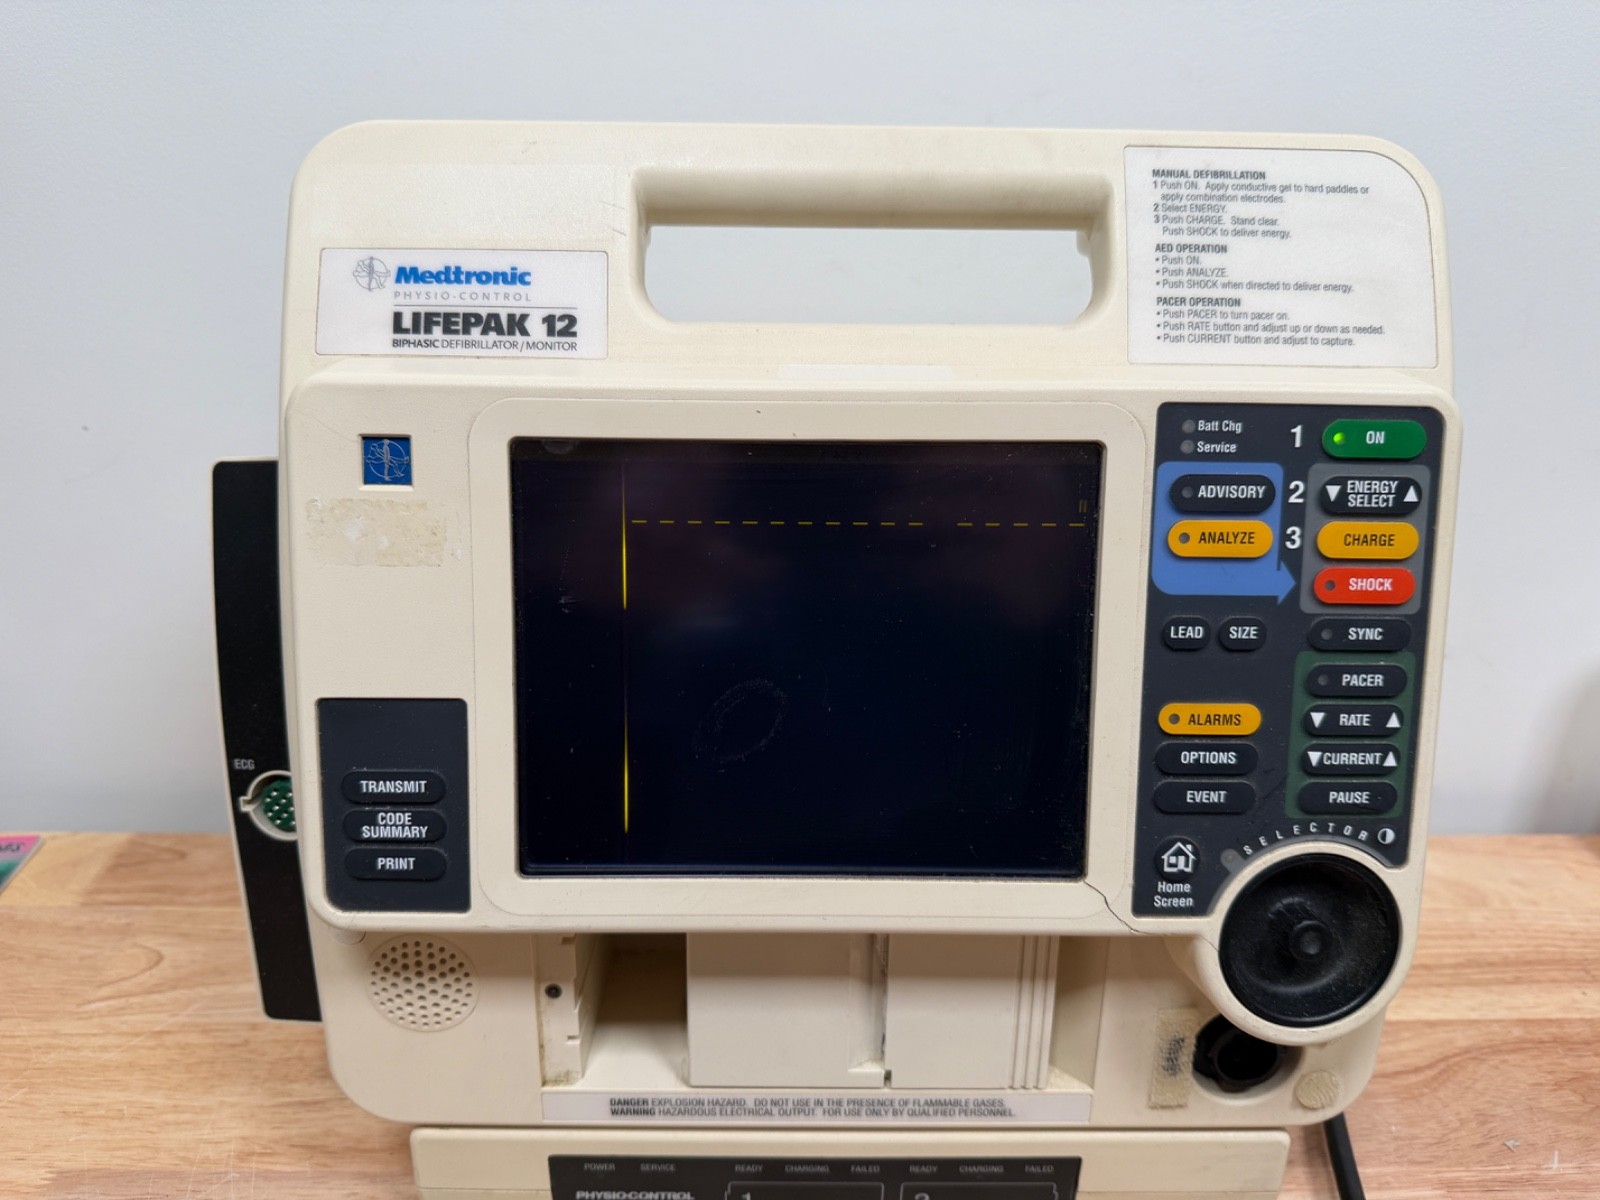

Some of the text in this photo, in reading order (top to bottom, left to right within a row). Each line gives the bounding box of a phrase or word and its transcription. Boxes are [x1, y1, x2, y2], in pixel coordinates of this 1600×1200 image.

[1152, 169, 1266, 180] MANUAL DEFIBRILLATION
[1152, 181, 1369, 195] 1 Push ON. Apply conductive gel to hard paddles or
[1160, 192, 1286, 203] apply combination electrodes.
[1153, 203, 1227, 214] 2 Select ENERGY.
[1153, 215, 1280, 226] 3 Push CHARGE. Stand clear.
[1162, 226, 1292, 240] Push SHOCK to deliver energy.
[1155, 243, 1228, 254] AED OPERATION
[1161, 255, 1202, 265] Push ON.
[394, 265, 532, 286] Medtronic
[1162, 267, 1229, 278] Push ANALYZE.
[1162, 279, 1354, 294] Push SHOCK when directed to deliver energy.
[394, 290, 532, 302] PHYSIO-CONTROL
[1156, 296, 1241, 307] PACER OPERATION
[1162, 309, 1290, 321] Push PACER to turn pacer on.
[392, 310, 578, 338] LIFEPAK 12
[1163, 321, 1385, 335] Push RATE button and adjust up or down as needed.
[392, 338, 578, 352] BIPHASIC DEFIBRILLATOR/MONITOR
[1163, 333, 1355, 347] Push CURRENT button and adjust to capture.
[1197, 420, 1243, 435] Batt Chg
[1290, 424, 1304, 448] 1
[1365, 430, 1385, 445] ON
[1197, 440, 1237, 453] Service
[1198, 485, 1266, 499] ADVISORY
[1288, 480, 1305, 503] 2
[1347, 480, 1399, 494] ENERGY
[1347, 494, 1396, 508] SELECT
[1198, 531, 1255, 545] ANALYZE
[1285, 526, 1302, 549] 3
[1343, 533, 1395, 547] CHARGE
[1348, 577, 1393, 592] SHOCK
[1170, 625, 1204, 639] LEAD
[1229, 625, 1259, 640] SIZE
[1348, 627, 1384, 641] SYNC
[1341, 673, 1384, 687] PACER
[1188, 713, 1242, 727] ALARMS
[1339, 713, 1371, 727] RATE
[233, 758, 256, 770] ECG
[1180, 751, 1237, 765] OPTIONS
[1322, 752, 1383, 766] CURRENT
[359, 780, 428, 793] TRANSMIT
[1186, 790, 1227, 804] EVENT
[1329, 791, 1371, 804] PAUSE
[377, 812, 412, 825] CODE
[362, 825, 429, 839] SUMMARY
[1242, 822, 1369, 856] SELECTOR
[376, 857, 416, 870] PRINT
[1157, 881, 1192, 893] Home
[1153, 895, 1194, 908] Screen
[610, 1097, 650, 1107] DANGER
[651, 1097, 705, 1107] EXPLOSION
[754, 1097, 768, 1107] DO
[770, 1097, 789, 1107] NOT
[791, 1097, 811, 1107] USE
[814, 1097, 824, 1107] IN
[827, 1098, 845, 1107] THE
[847, 1098, 899, 1107] PRESENCE
[900, 1098, 911, 1107] OF
[912, 1098, 971, 1107] FLAMMABLE
[610, 1107, 656, 1117] WARNING
[658, 1107, 717, 1117] HAZARDOUS
[719, 1107, 775, 1117] ELECTRICAL
[823, 1107, 842, 1117] FOR
[844, 1107, 863, 1117] USE
[865, 1107, 891, 1117] ONLY
[892, 1107, 905, 1117] BY
[906, 1107, 957, 1117] QUALIFIED
[584, 1162, 615, 1171] POWER
[640, 1163, 676, 1172] SERVICE
[735, 1163, 763, 1173] READY
[785, 1164, 831, 1173] CHARGING
[851, 1165, 880, 1173] FAILED
[909, 1165, 938, 1173] READY
[959, 1165, 1005, 1174] CHARGING
[1024, 1165, 1054, 1174] FAILED
